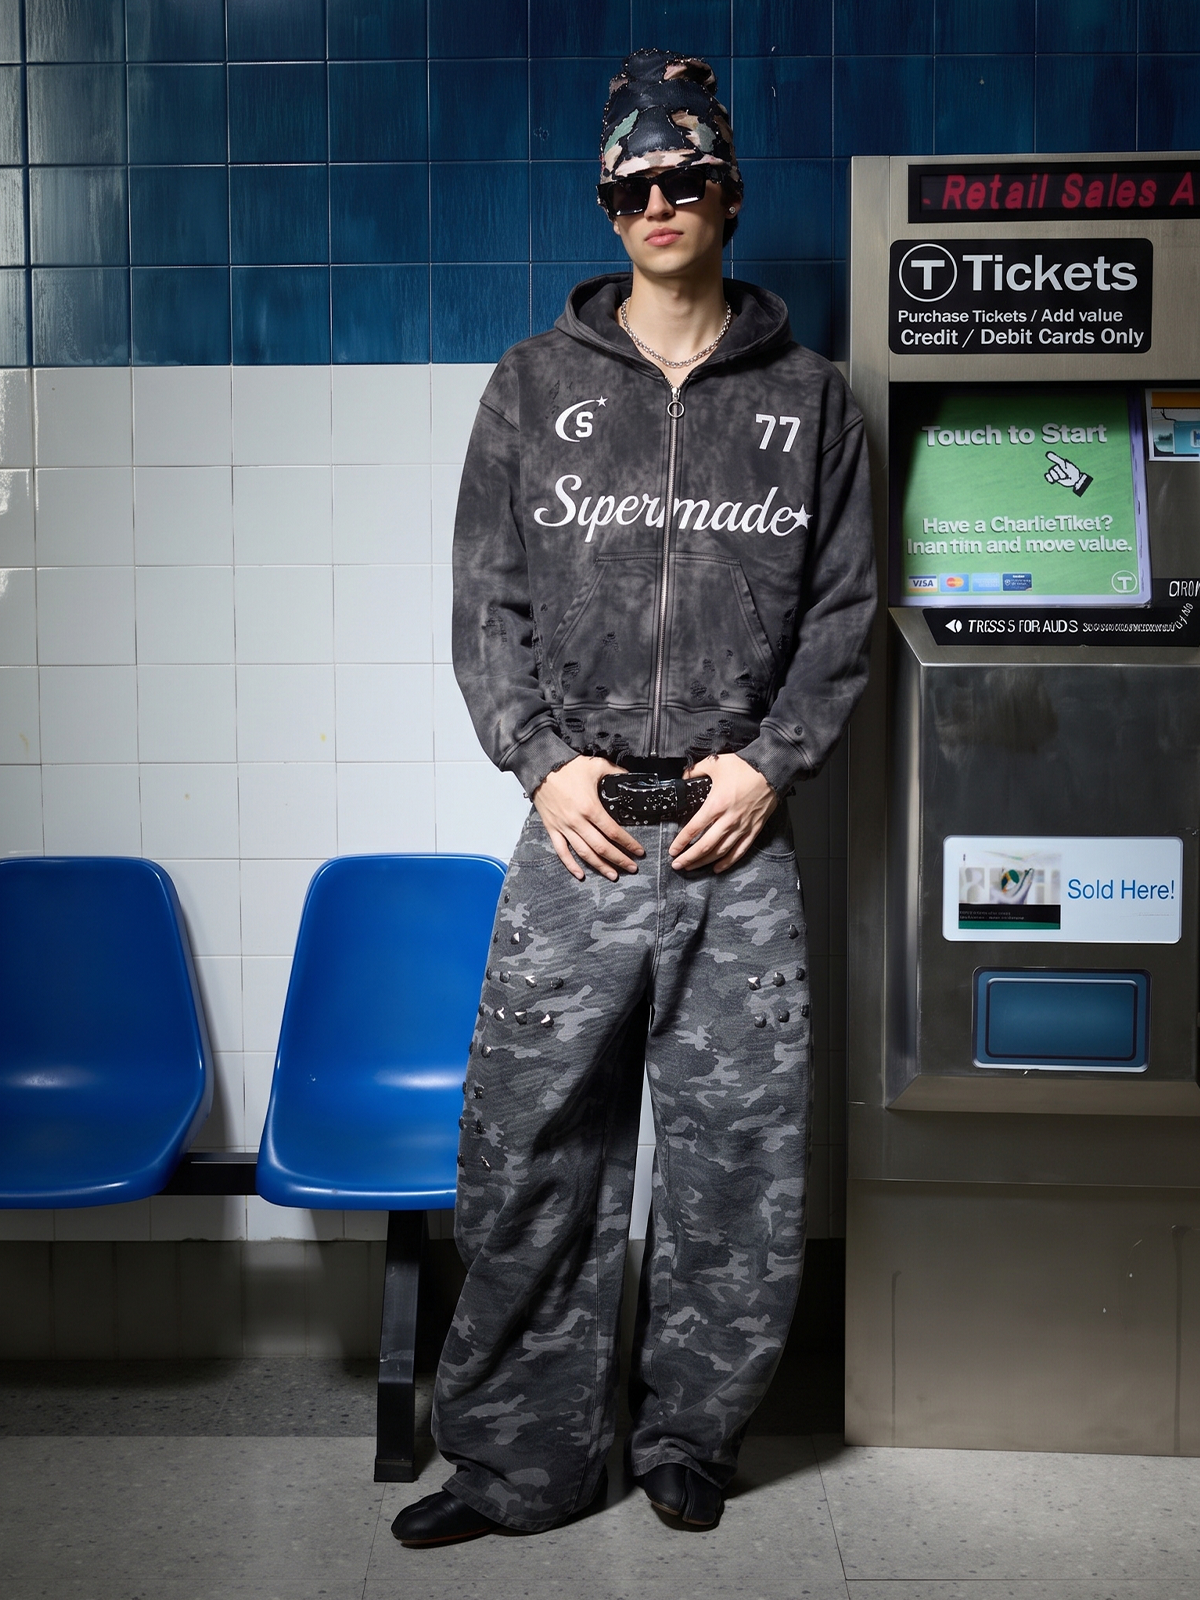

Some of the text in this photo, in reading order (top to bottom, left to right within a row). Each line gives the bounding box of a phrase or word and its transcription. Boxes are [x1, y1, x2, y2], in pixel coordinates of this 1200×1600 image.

[942, 174, 1049, 210] Retail
[1061, 172, 1157, 210] Sales
[1169, 171, 1194, 206] A
[910, 254, 1138, 292] T Tickets
[898, 310, 969, 323] Purchase
[972, 309, 1027, 323] Tickets
[1041, 308, 1074, 322] Add
[1079, 308, 1123, 321] value
[901, 329, 958, 345] Credit
[981, 328, 1033, 344] Debit
[1038, 327, 1095, 344] Cards
[1100, 326, 1144, 347] Only
[755, 413, 800, 452] 77
[922, 423, 1107, 446] Touch to Start
[923, 514, 1113, 533] Have a CharlieTiket?
[986, 536, 1021, 552] and
[1026, 537, 1075, 551] move
[1079, 535, 1132, 551] value.
[913, 579, 934, 587] VISA
[1117, 576, 1132, 591] T
[1067, 879, 1175, 900] Sold Here!
